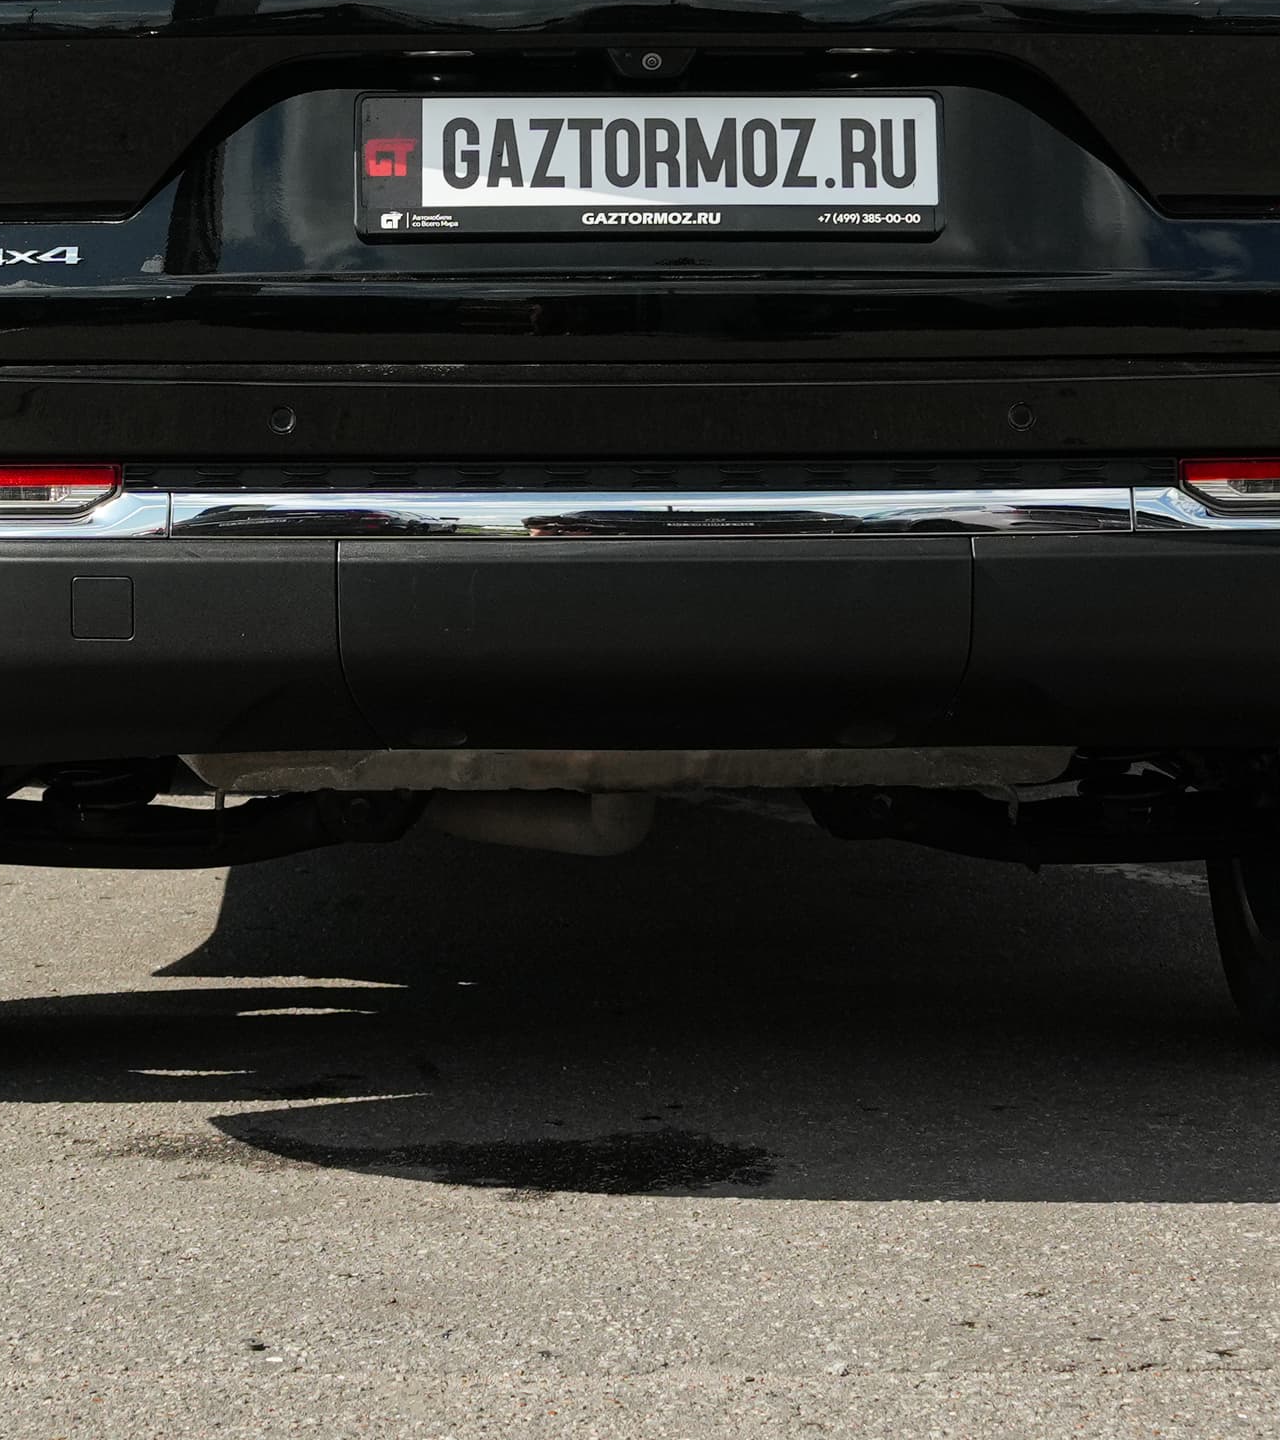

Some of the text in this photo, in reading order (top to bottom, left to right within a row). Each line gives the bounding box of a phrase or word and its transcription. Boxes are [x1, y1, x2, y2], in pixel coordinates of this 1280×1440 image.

[442, 117, 917, 189] GAZTORMOZ.RU
[581, 211, 721, 225] GAZTORMOZ.RU
[818, 212, 921, 225] +7 (499) 385-00-00
